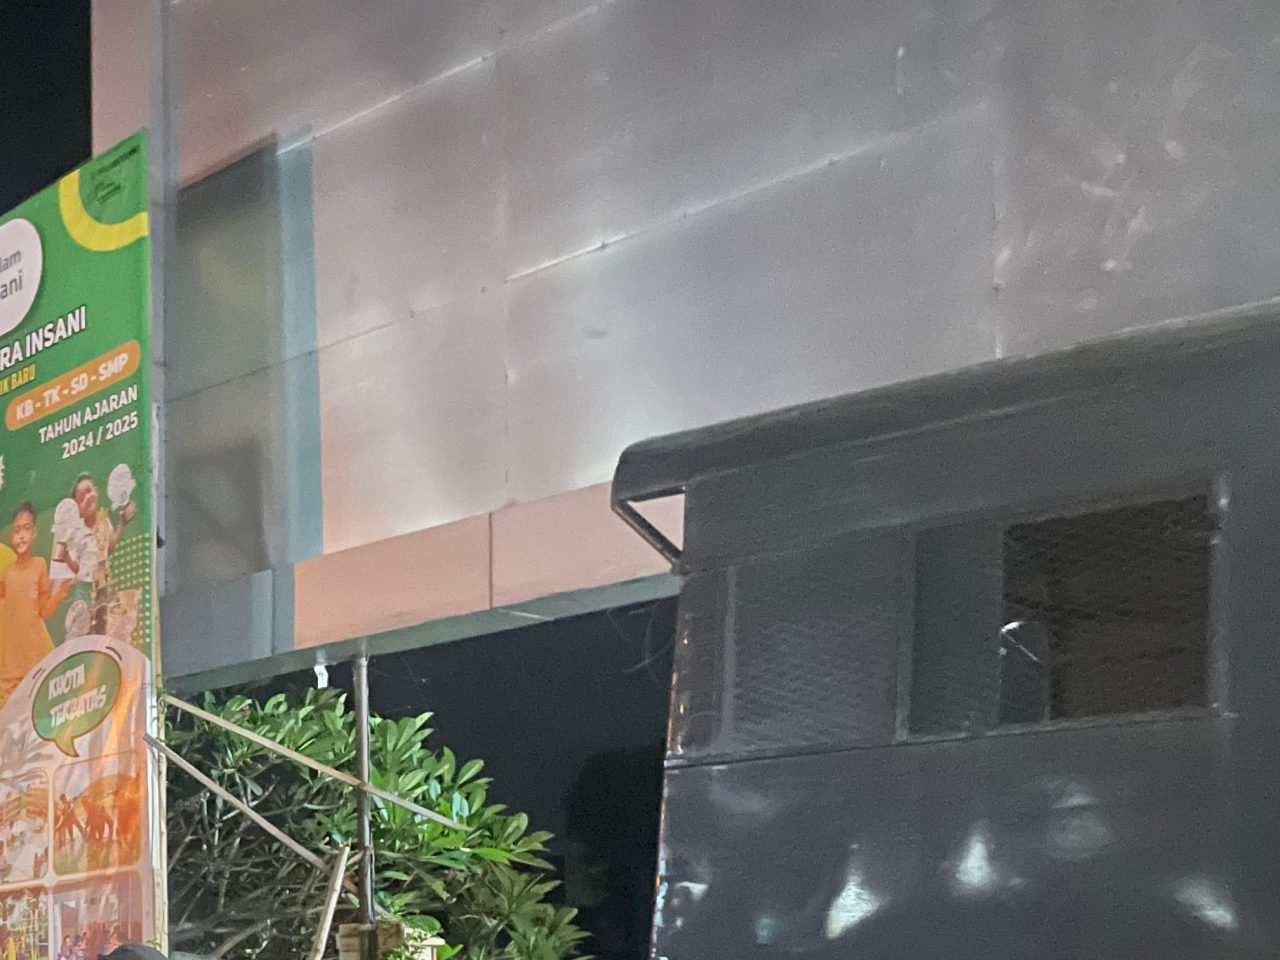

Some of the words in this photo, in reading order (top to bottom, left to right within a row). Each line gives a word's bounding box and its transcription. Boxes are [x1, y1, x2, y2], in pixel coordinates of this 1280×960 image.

[26, 306, 86, 358] INSANI
[11, 363, 36, 390] BARU
[16, 399, 34, 421] KB
[42, 385, 61, 408] TK
[71, 372, 89, 395] SD
[98, 352, 129, 382] SMP
[38, 411, 81, 444] TAHUN
[83, 384, 138, 424] AJARAN
[62, 431, 94, 460] 2024
[105, 411, 138, 440] 2025
